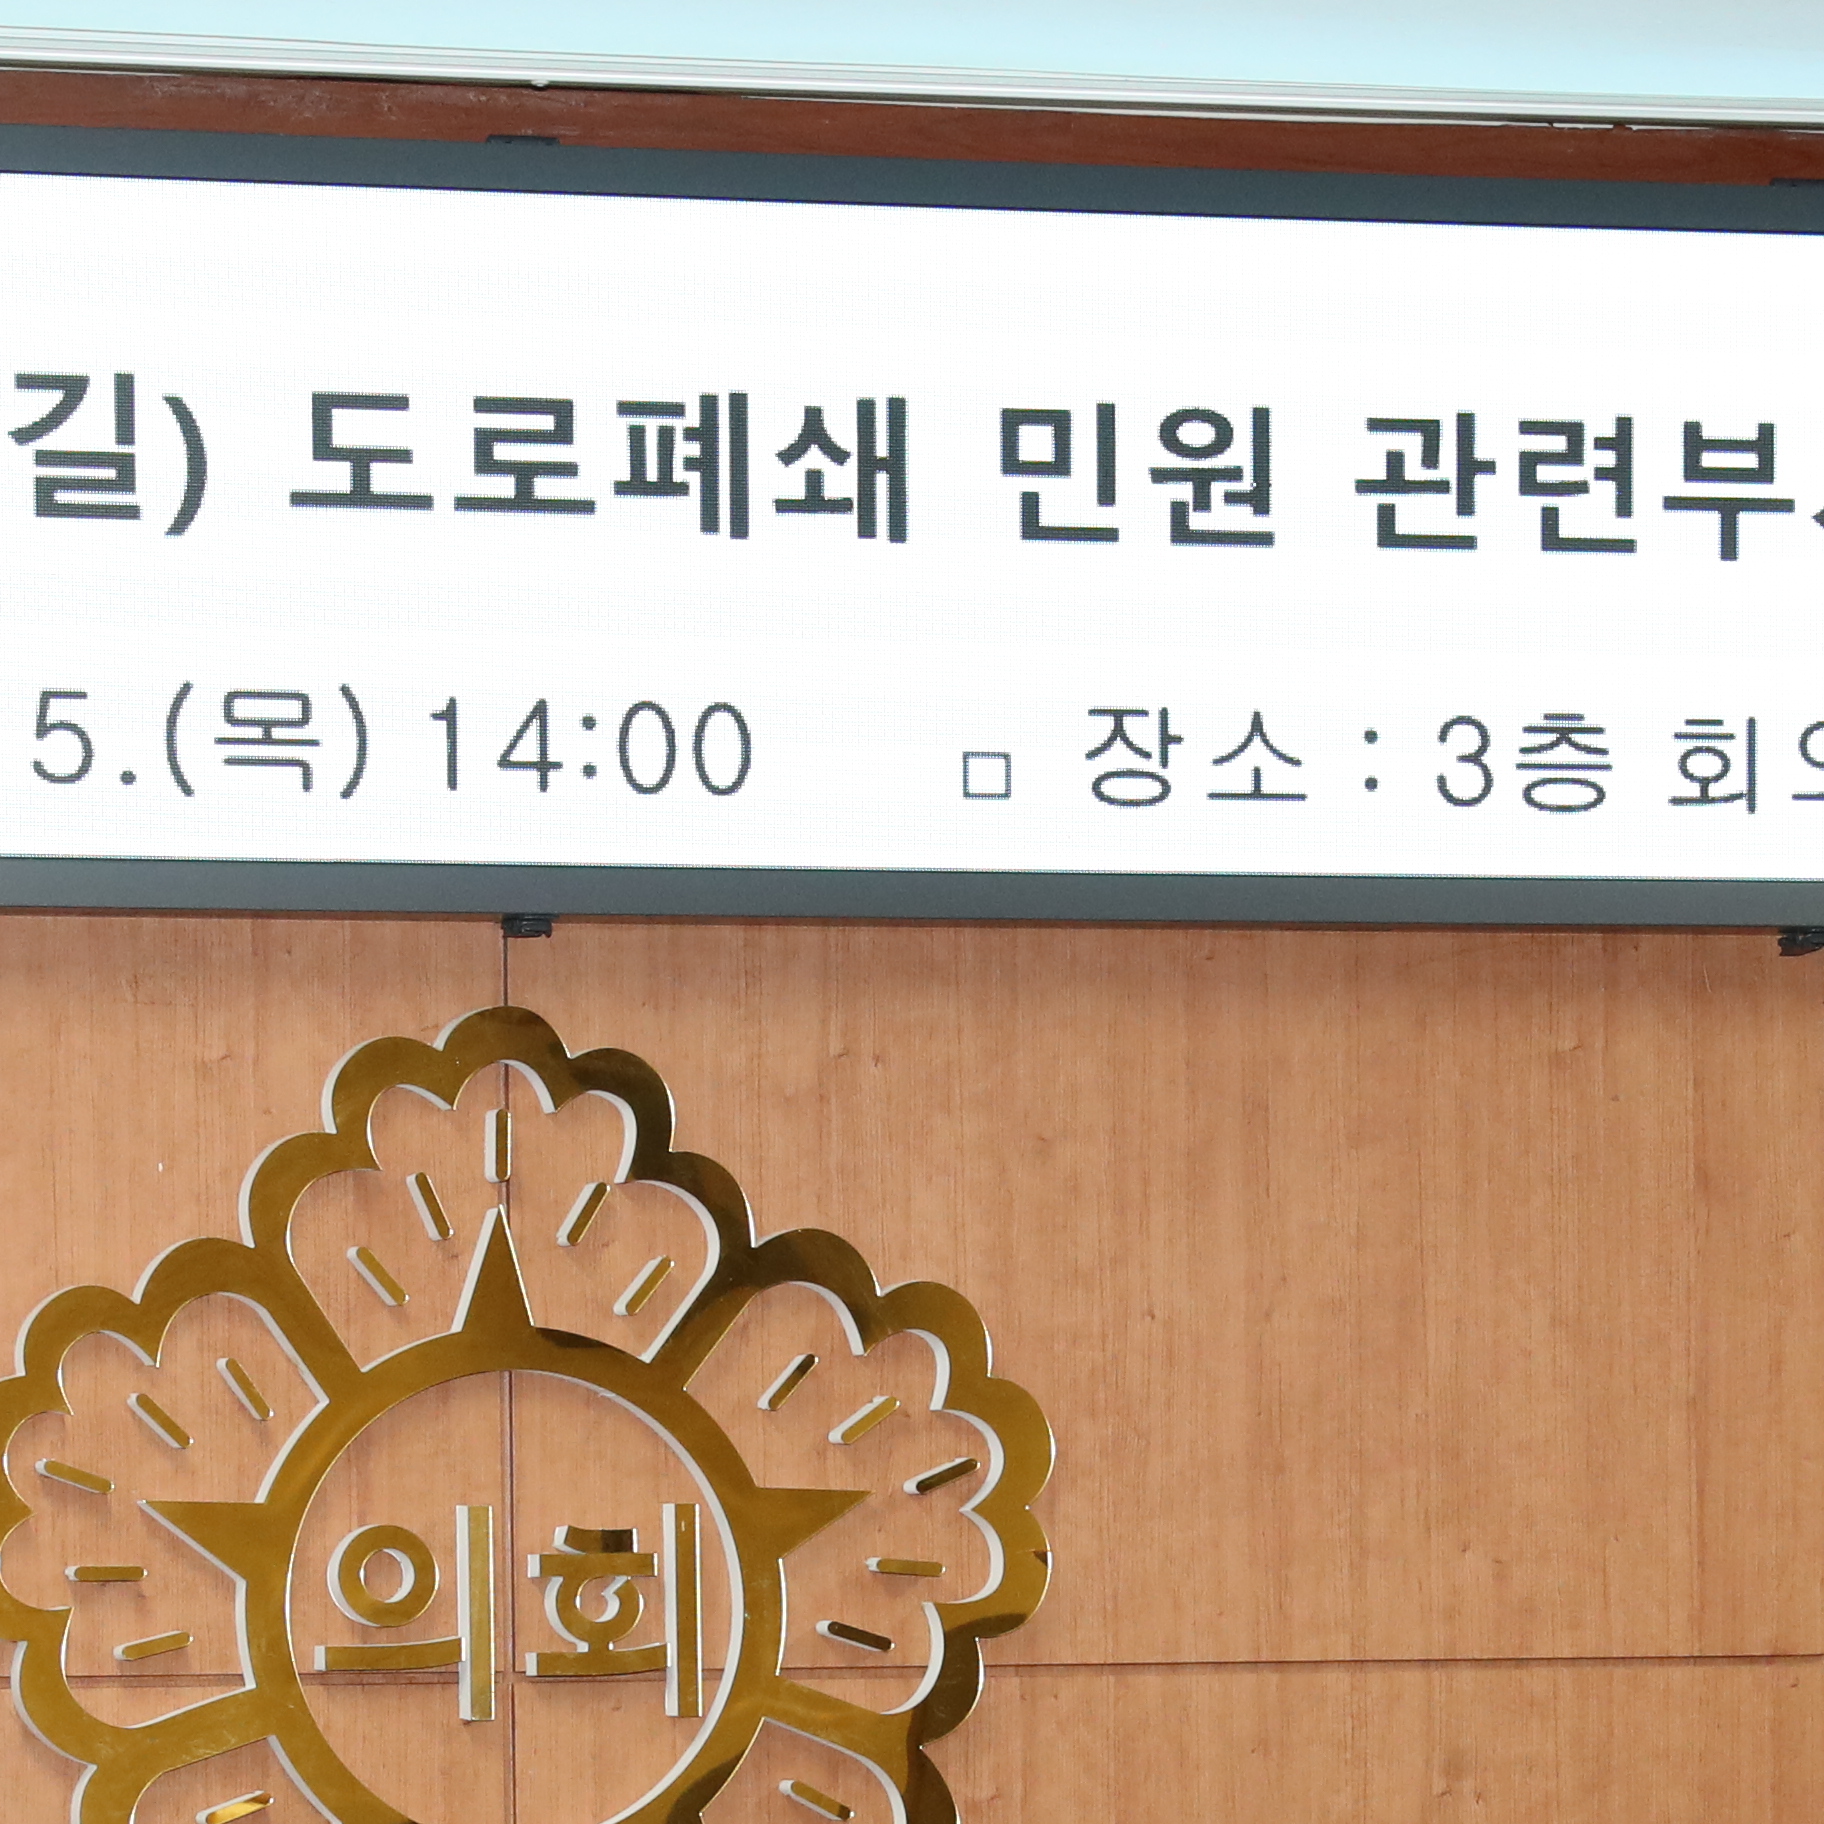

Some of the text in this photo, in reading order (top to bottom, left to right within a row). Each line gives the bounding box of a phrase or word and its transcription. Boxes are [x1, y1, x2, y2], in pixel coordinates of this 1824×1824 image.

[291, 392, 907, 543] 도로폐쇄
[1001, 403, 1274, 546] 민원
[432, 698, 751, 796] 14:00
[1086, 708, 1306, 808] 장소
[1437, 713, 1611, 813] 3층
[314, 1503, 702, 1722] 의회
